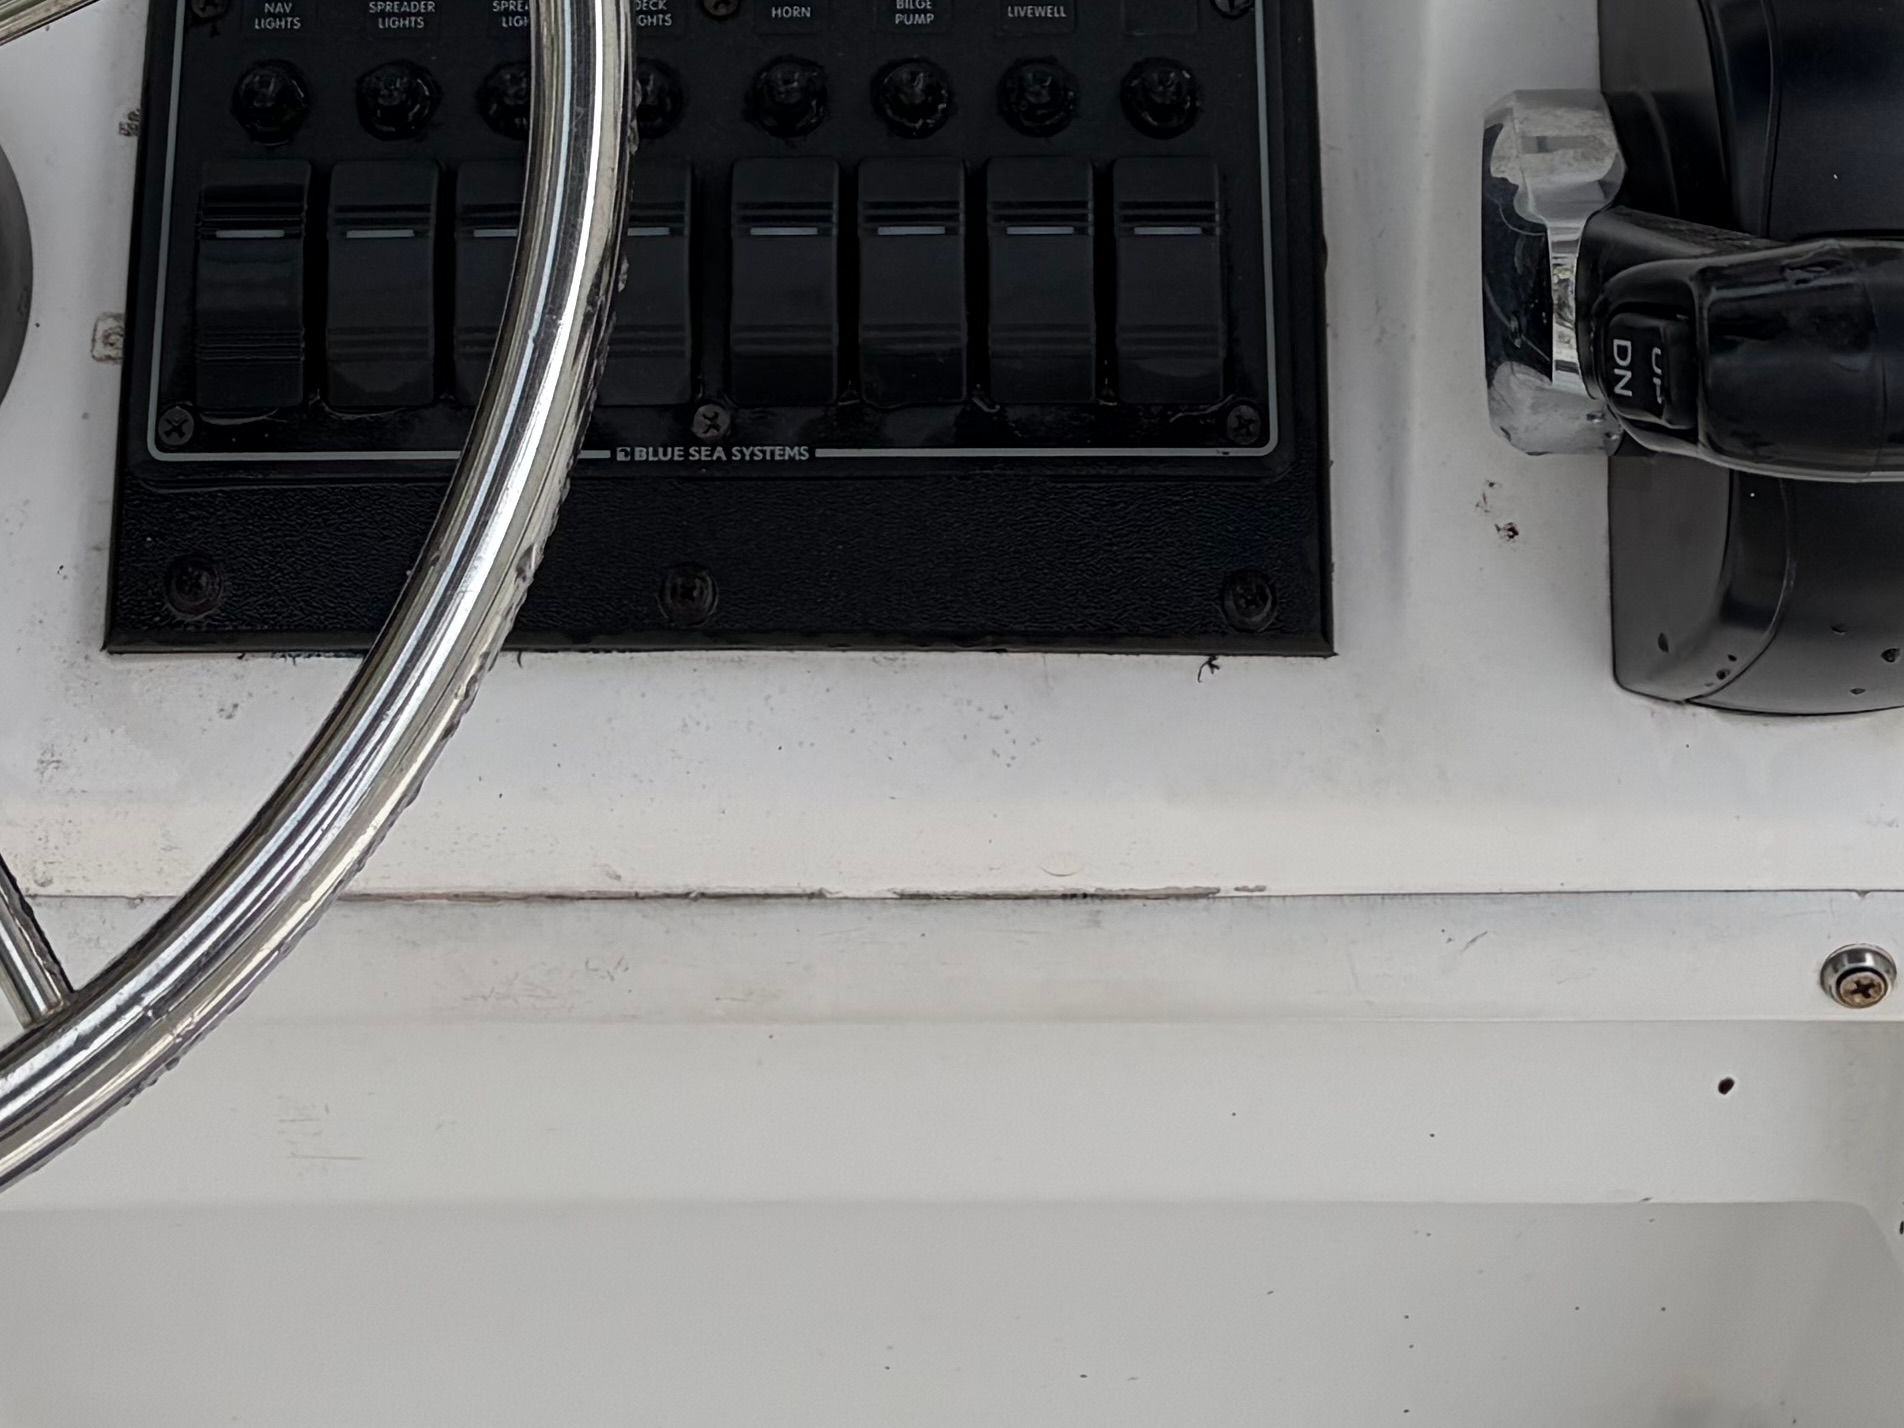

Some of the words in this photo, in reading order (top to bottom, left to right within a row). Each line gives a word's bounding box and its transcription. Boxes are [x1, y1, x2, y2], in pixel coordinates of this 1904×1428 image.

[264, 2, 293, 14] NAV
[368, 0, 436, 13] SPREADER
[492, 0, 529, 12] SPRE
[635, 0, 668, 11] DECK
[771, 6, 811, 18] HORN
[1007, 5, 1067, 18] LIVEWELL
[254, 17, 302, 30] LIGHTS
[378, 16, 425, 29] LIGHTS
[501, 16, 529, 28] LIGH
[637, 14, 673, 26] GHTS
[895, 12, 935, 25] PUMP
[1612, 338, 1633, 397] DN
[634, 446, 685, 461] BLUE
[688, 446, 727, 461] SEA
[731, 445, 810, 461] SYSTEMS
